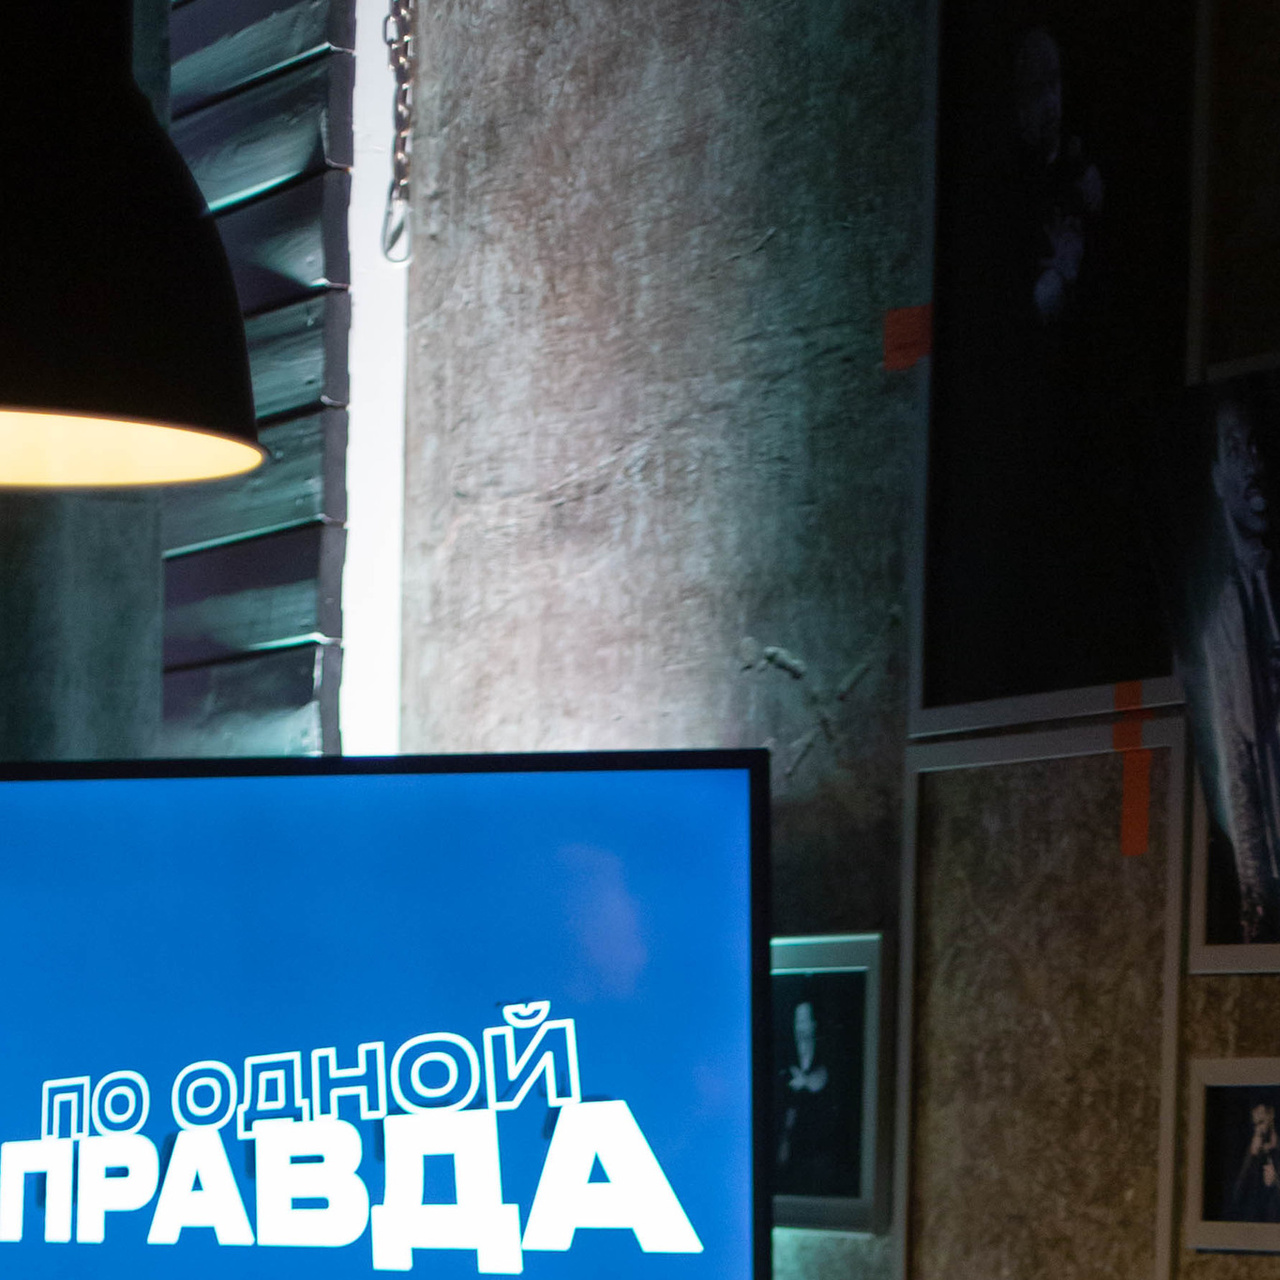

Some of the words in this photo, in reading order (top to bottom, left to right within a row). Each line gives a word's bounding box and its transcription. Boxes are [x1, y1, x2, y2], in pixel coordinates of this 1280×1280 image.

[41, 1070, 150, 1142] ПО
[171, 1001, 582, 1140] ОДНОЙ
[0, 1100, 704, 1274] ПРАВДА
